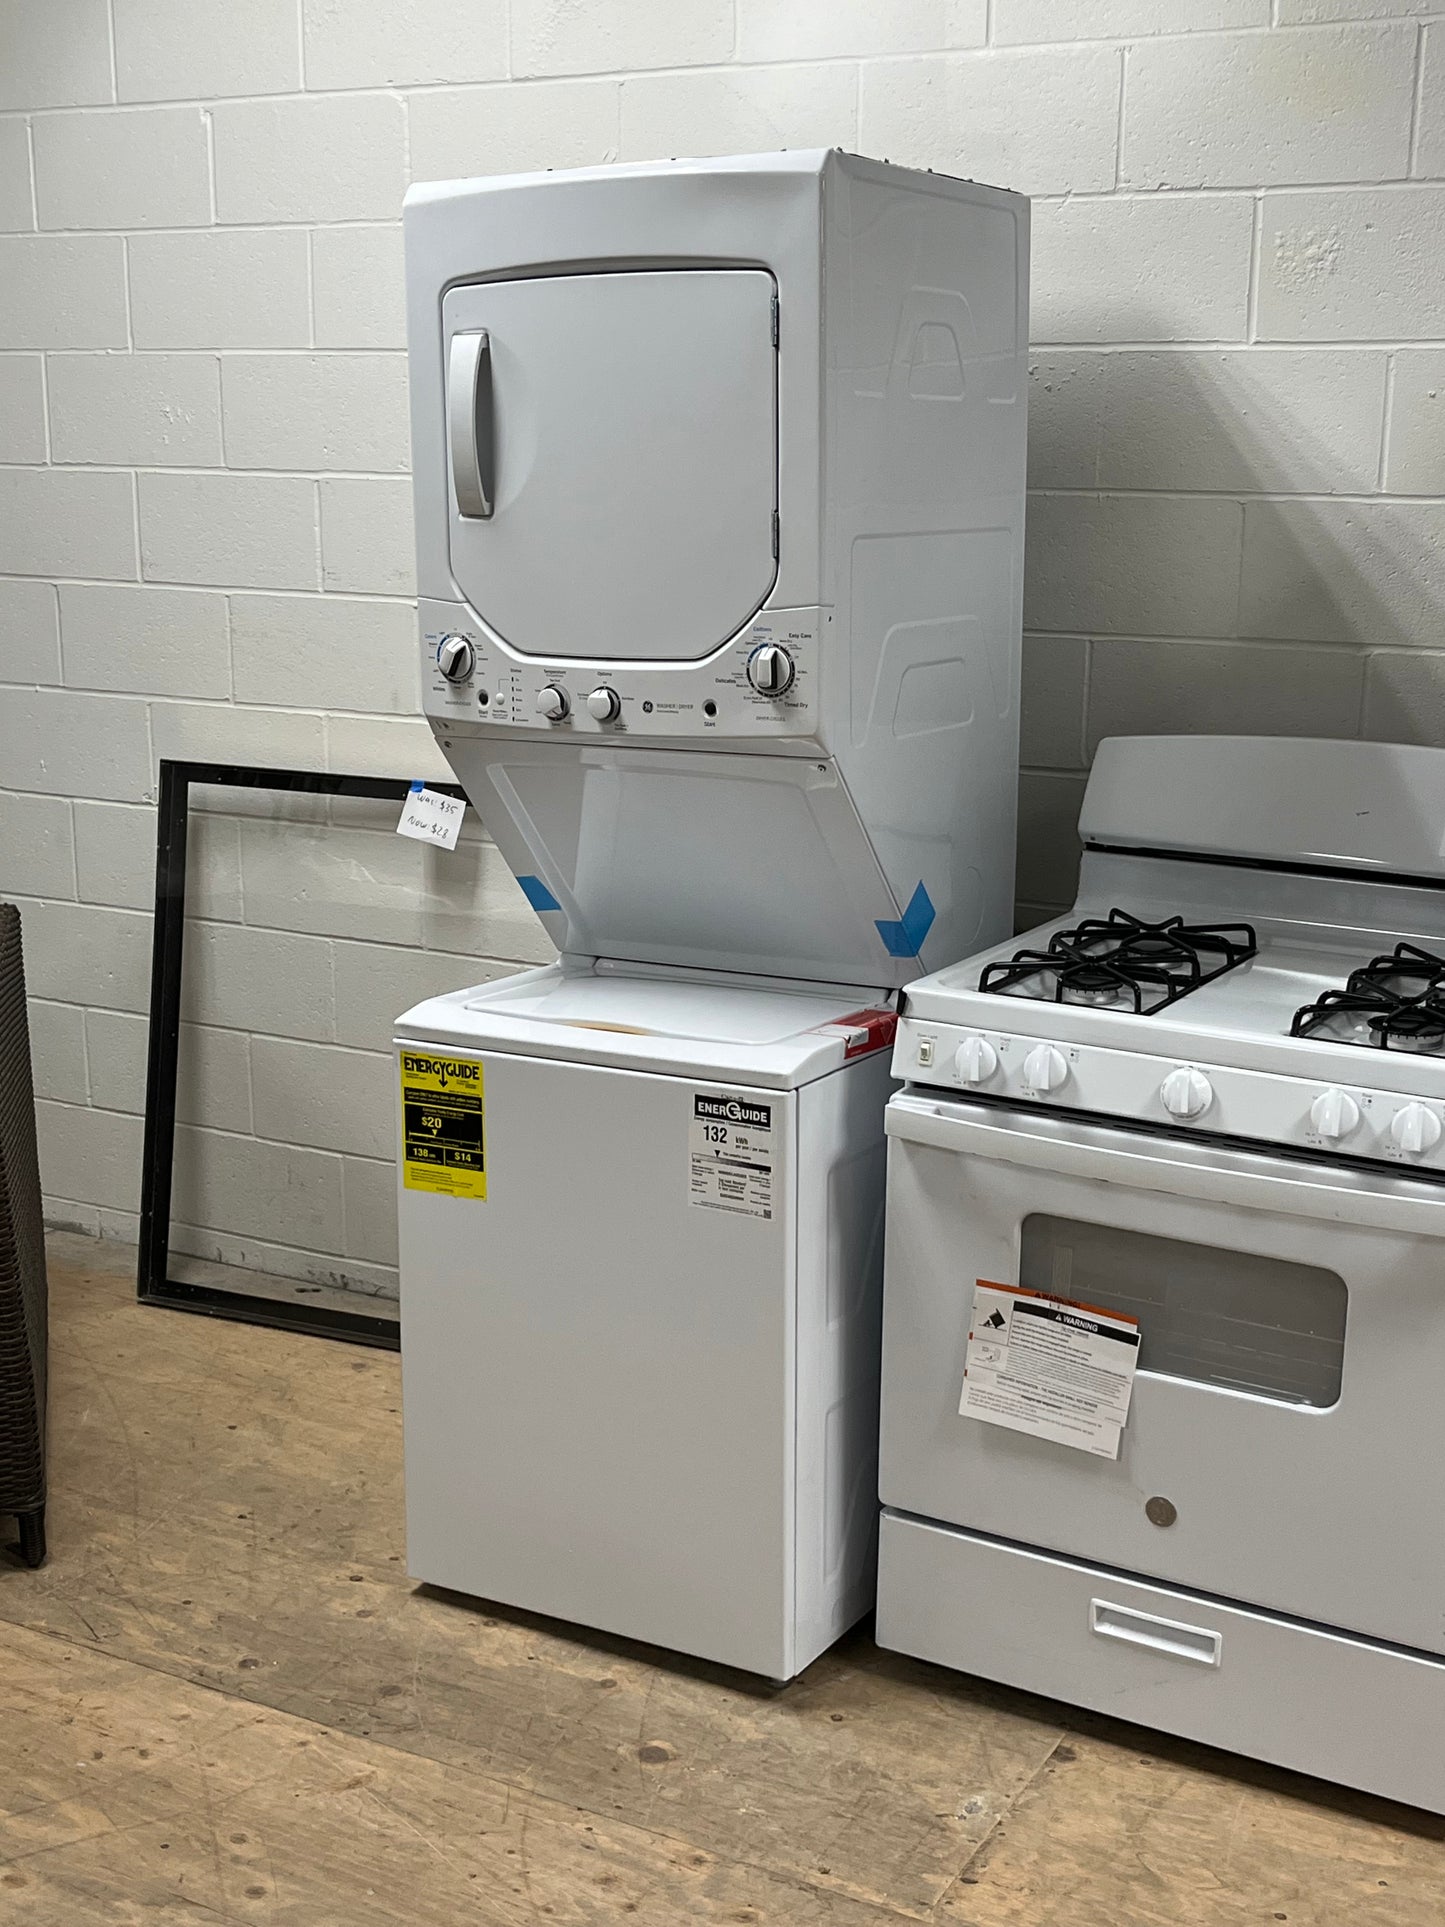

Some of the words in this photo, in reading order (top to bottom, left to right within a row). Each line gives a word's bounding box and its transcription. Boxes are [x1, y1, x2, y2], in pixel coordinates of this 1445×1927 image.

[439, 800, 459, 815] $35
[431, 822, 450, 840] $28
[404, 1055, 480, 1081] ENERGYGUIDE
[697, 1101, 768, 1123] ENERGUIDE
[421, 1116, 442, 1129] $20
[703, 1125, 728, 1144] 132
[412, 1147, 429, 1158] 138
[454, 1151, 472, 1162] $14
[1062, 1314, 1099, 1333] WARNING
